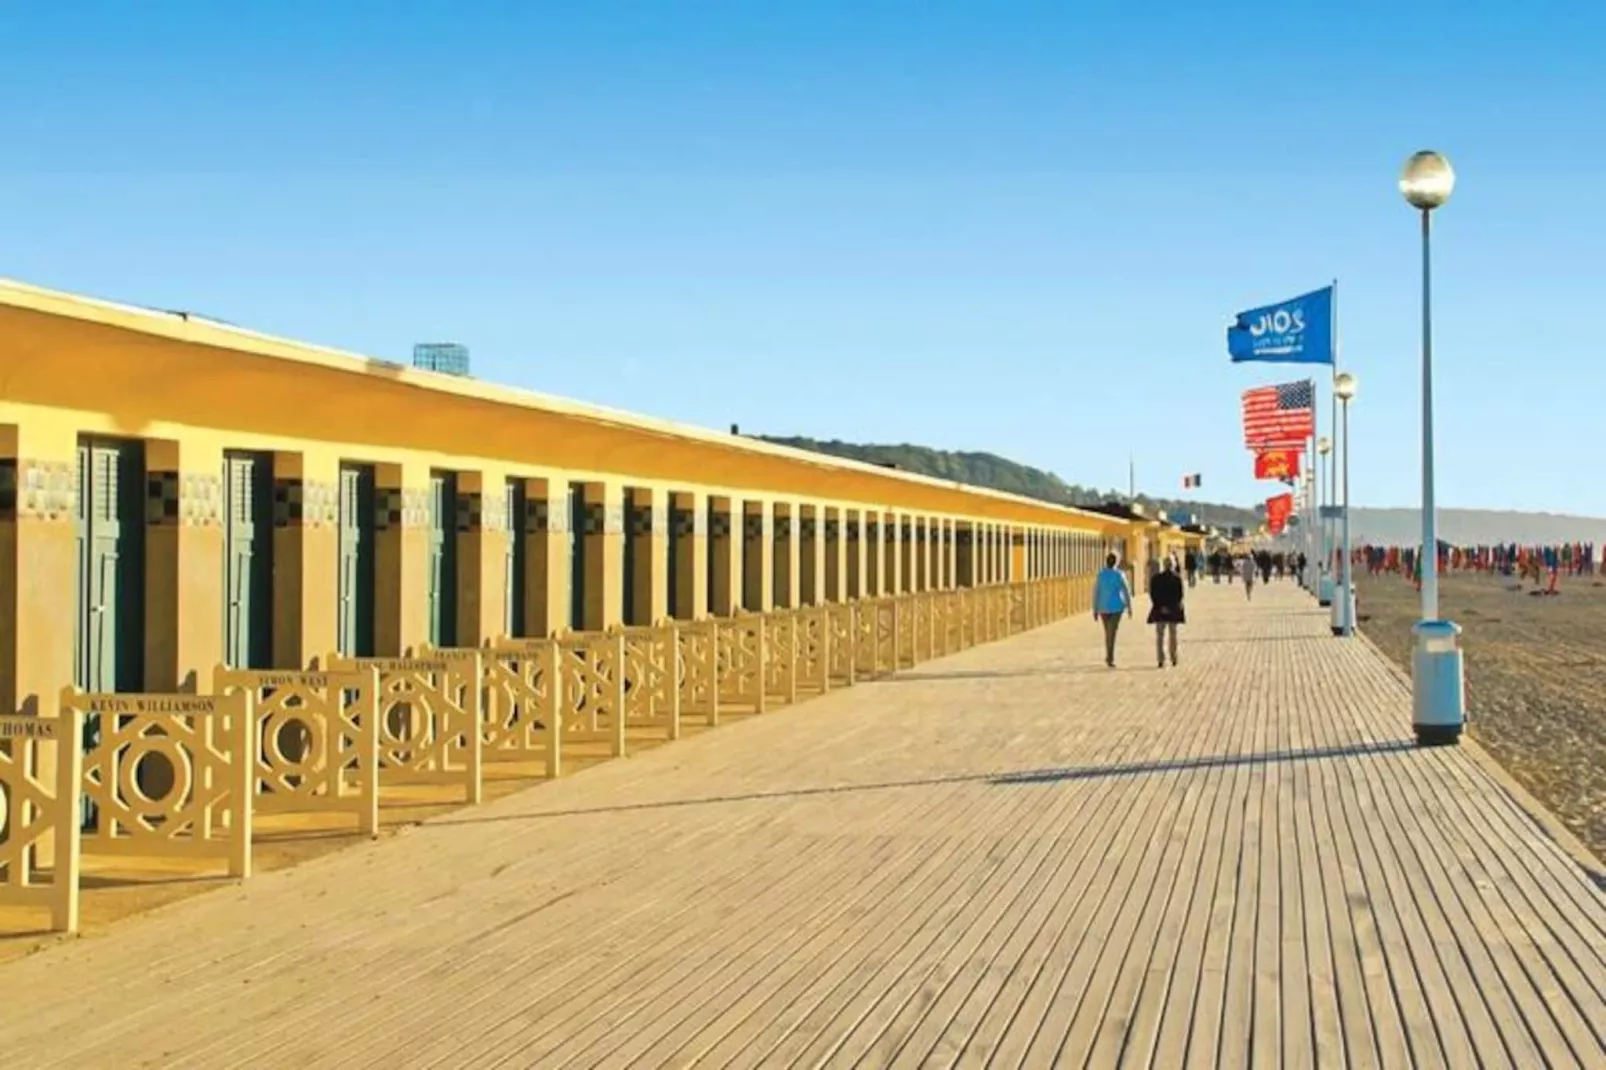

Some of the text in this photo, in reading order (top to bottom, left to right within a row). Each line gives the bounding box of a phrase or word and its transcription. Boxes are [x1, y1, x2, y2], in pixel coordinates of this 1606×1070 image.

[91, 700, 216, 712] KEVIN WILLIAMSON
[0, 721, 53, 737] HOMAS
